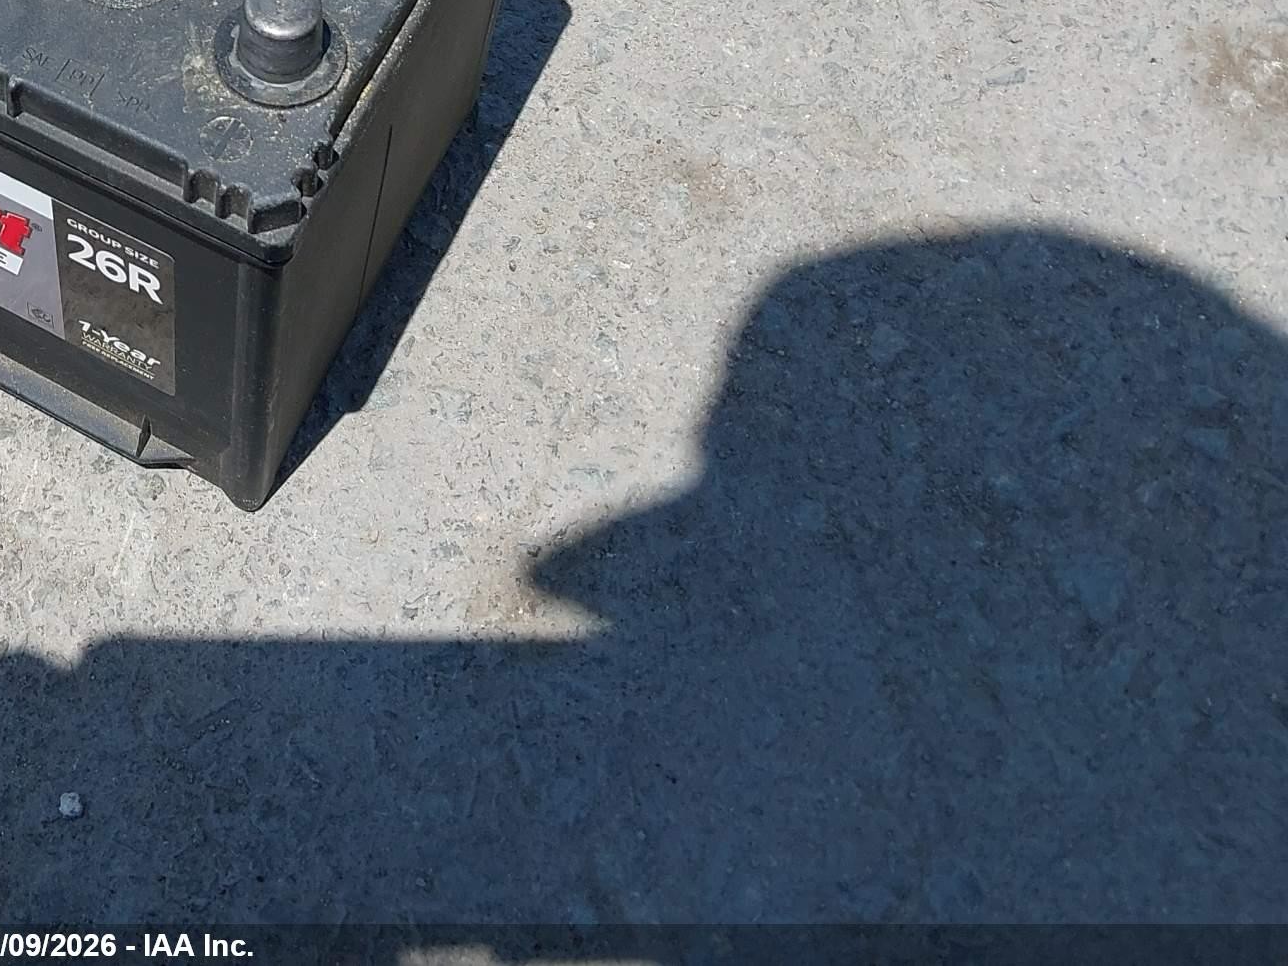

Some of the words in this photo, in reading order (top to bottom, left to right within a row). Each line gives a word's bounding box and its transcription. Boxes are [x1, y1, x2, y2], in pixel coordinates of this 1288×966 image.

[67, 218, 123, 249] GROUP
[124, 245, 161, 270] SIZE
[67, 233, 164, 305] 26R
[78, 320, 161, 365] 1-Year
[81, 331, 154, 372] WARRANTY
[81, 340, 102, 356] FREE
[100, 349, 155, 381] REPLACEMENT
